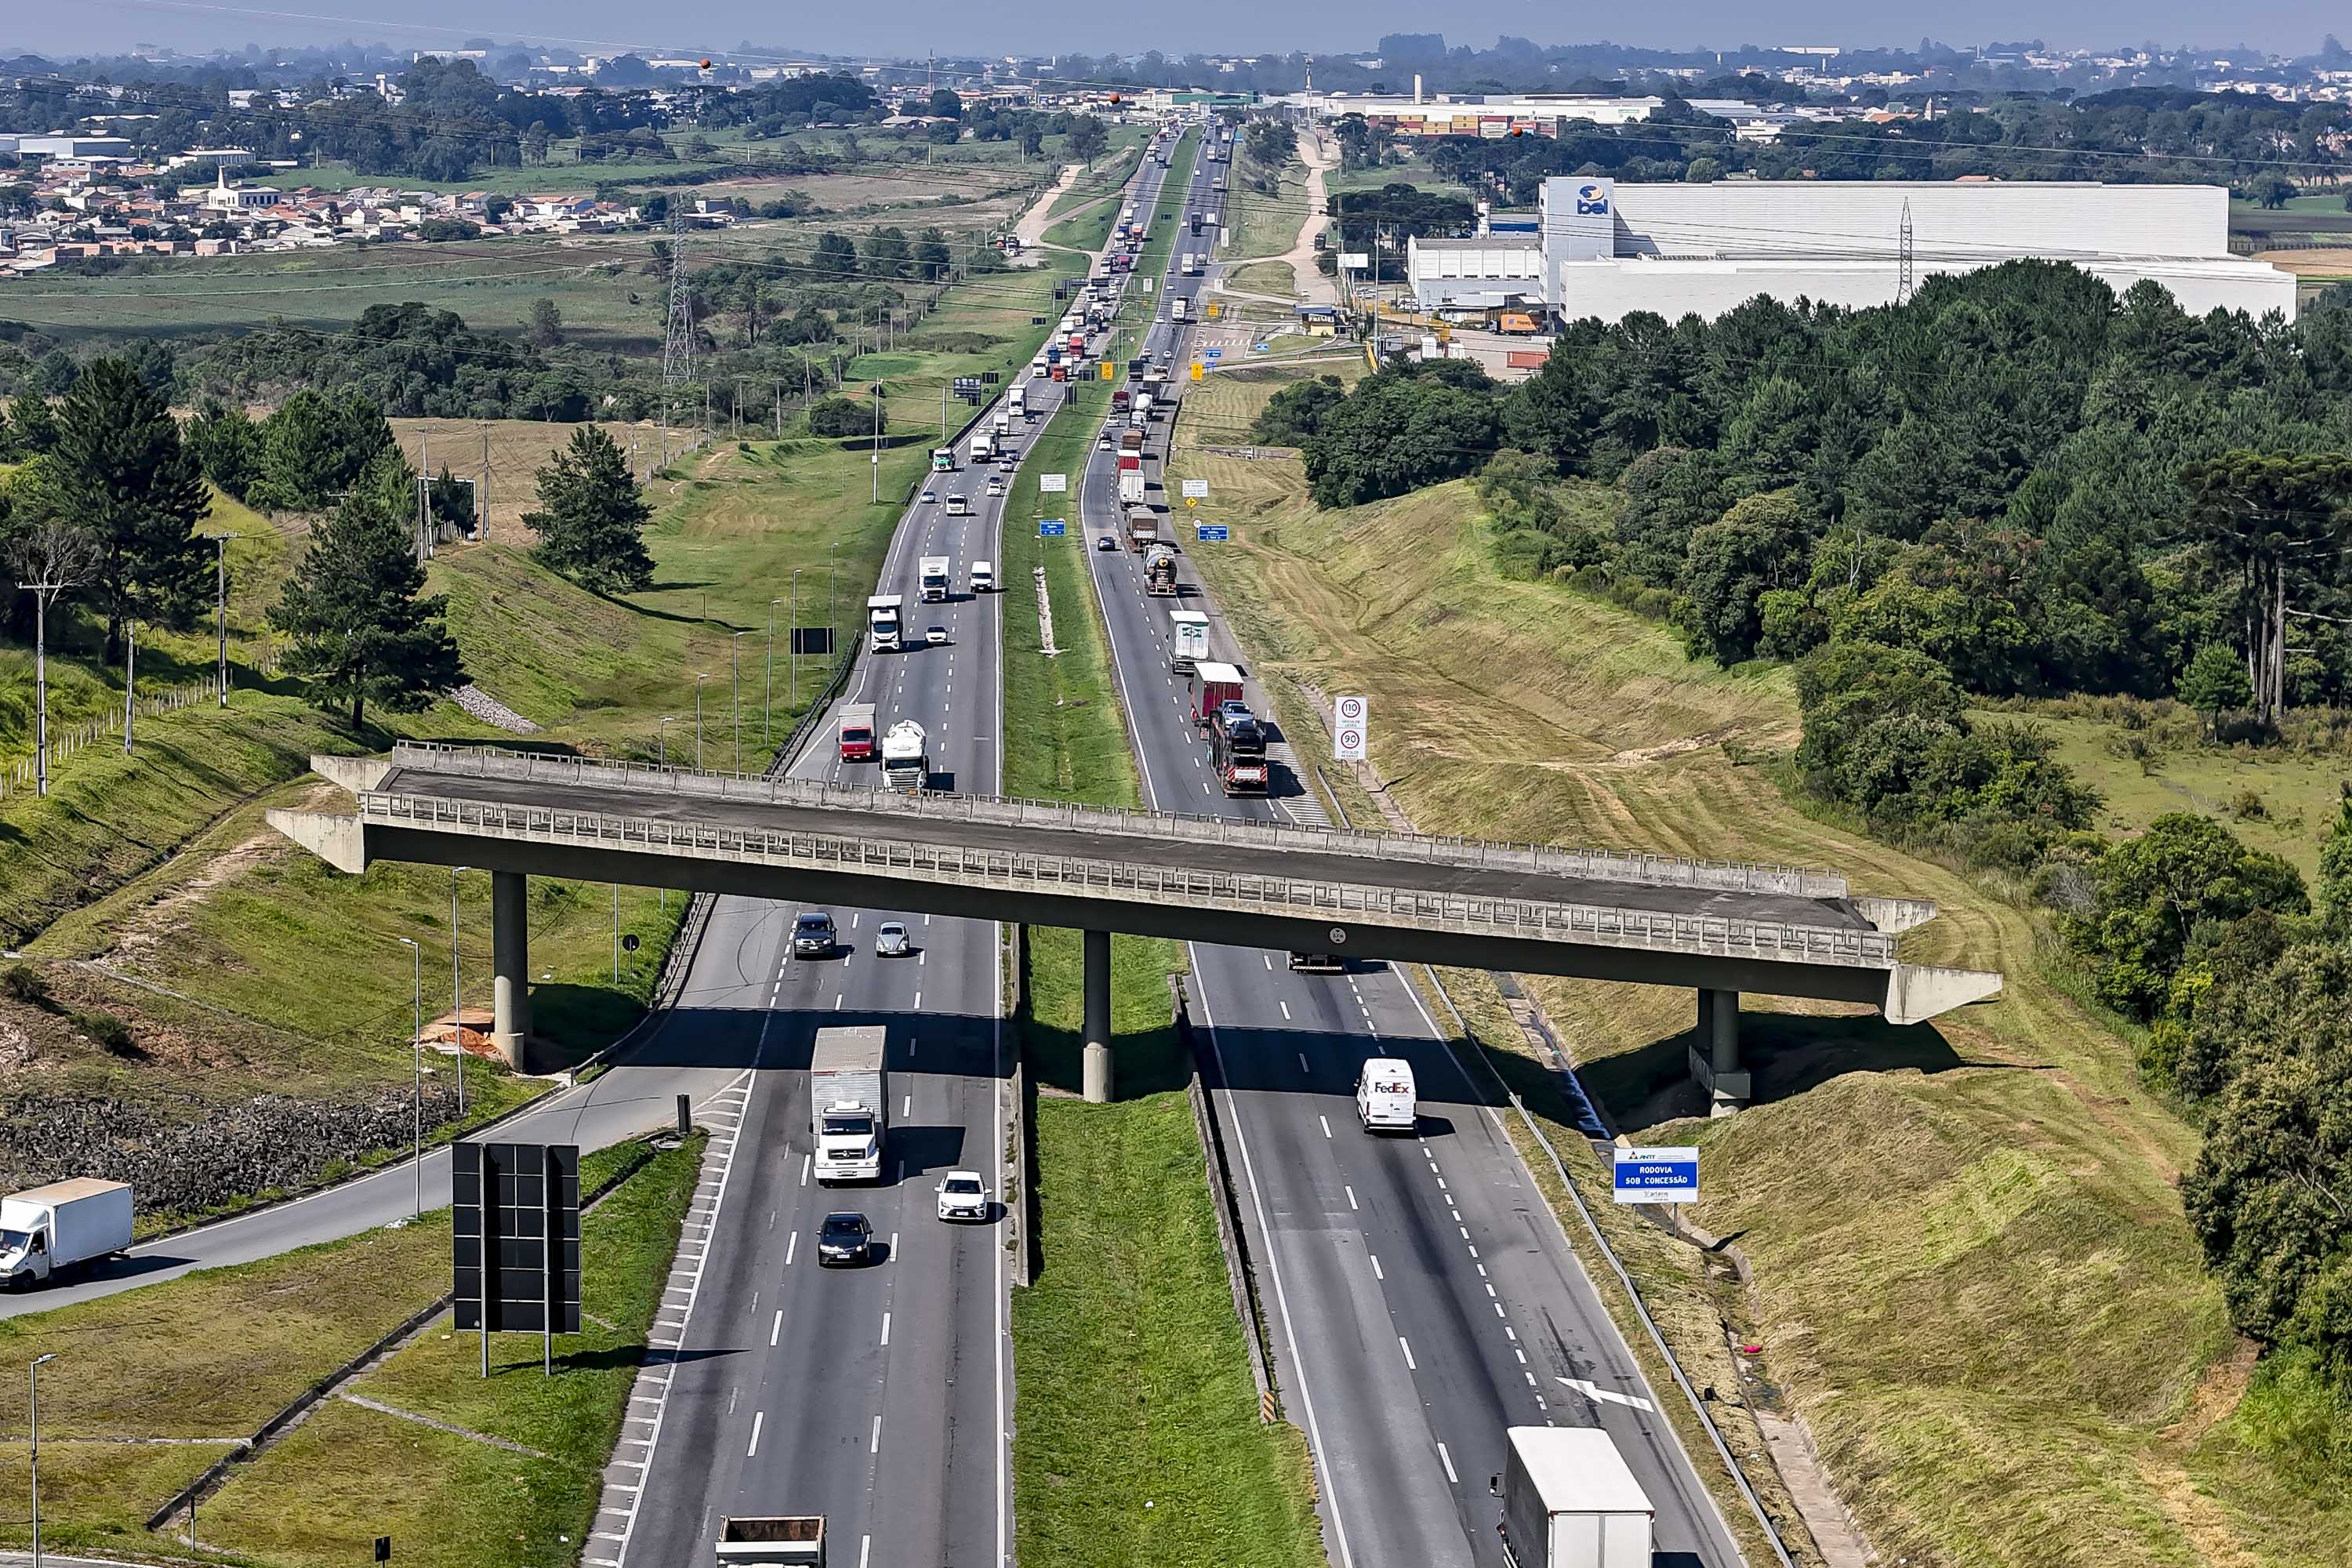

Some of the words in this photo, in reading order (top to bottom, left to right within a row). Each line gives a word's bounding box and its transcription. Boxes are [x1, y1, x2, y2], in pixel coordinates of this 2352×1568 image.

[1577, 198, 1608, 215] bel
[1375, 1082, 1410, 1094] FedEx
[1644, 1175, 1688, 1185] CONCESSÃO
